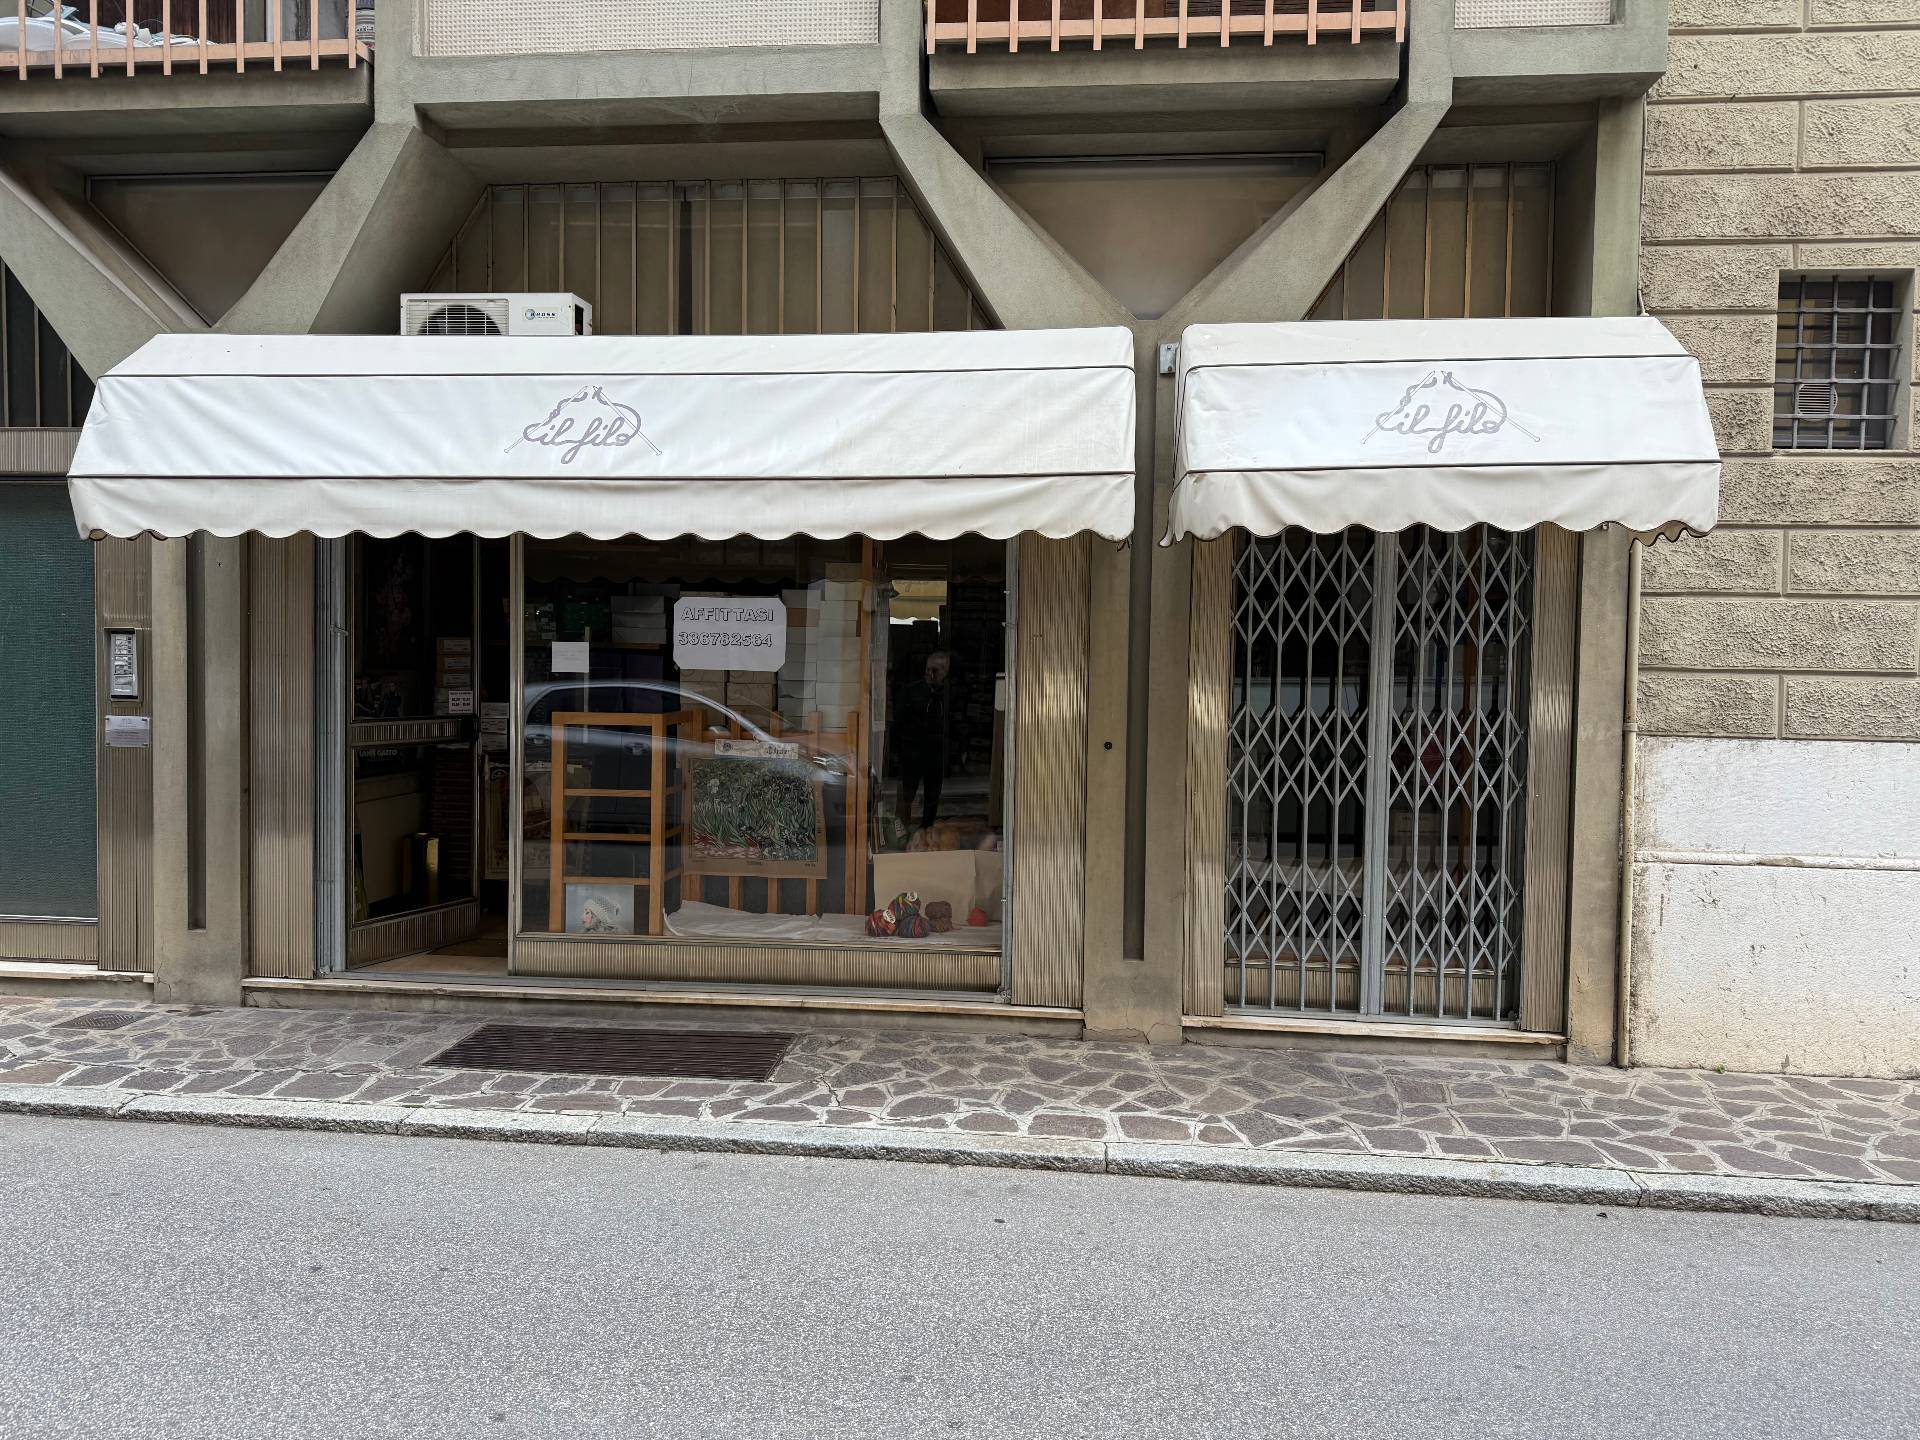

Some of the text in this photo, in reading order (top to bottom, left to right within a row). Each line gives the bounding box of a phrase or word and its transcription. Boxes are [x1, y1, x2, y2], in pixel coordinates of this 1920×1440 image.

[560, 416, 632, 465] filo
[1427, 402, 1501, 454] filo
[681, 607, 774, 621] AFFITTASI
[678, 631, 772, 647] 336782564
